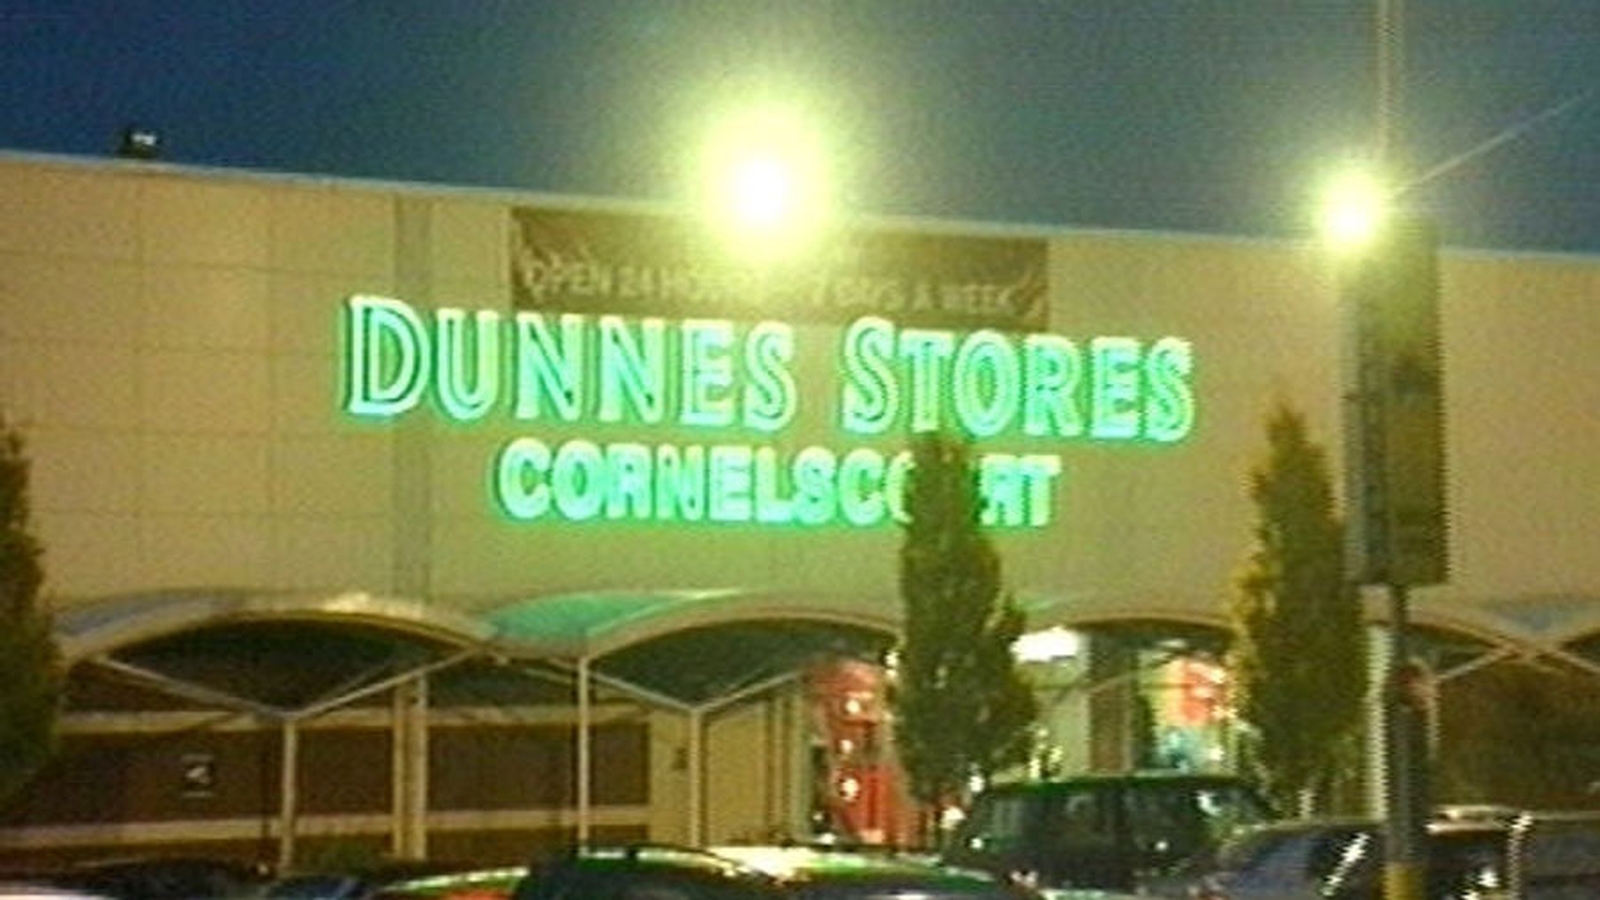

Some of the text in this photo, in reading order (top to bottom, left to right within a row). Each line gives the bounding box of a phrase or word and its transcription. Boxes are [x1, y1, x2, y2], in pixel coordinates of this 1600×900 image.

[523, 257, 612, 301] OPEN
[346, 294, 1195, 442] DUNNES STORES
[497, 437, 1062, 526] CORNELSCORT
